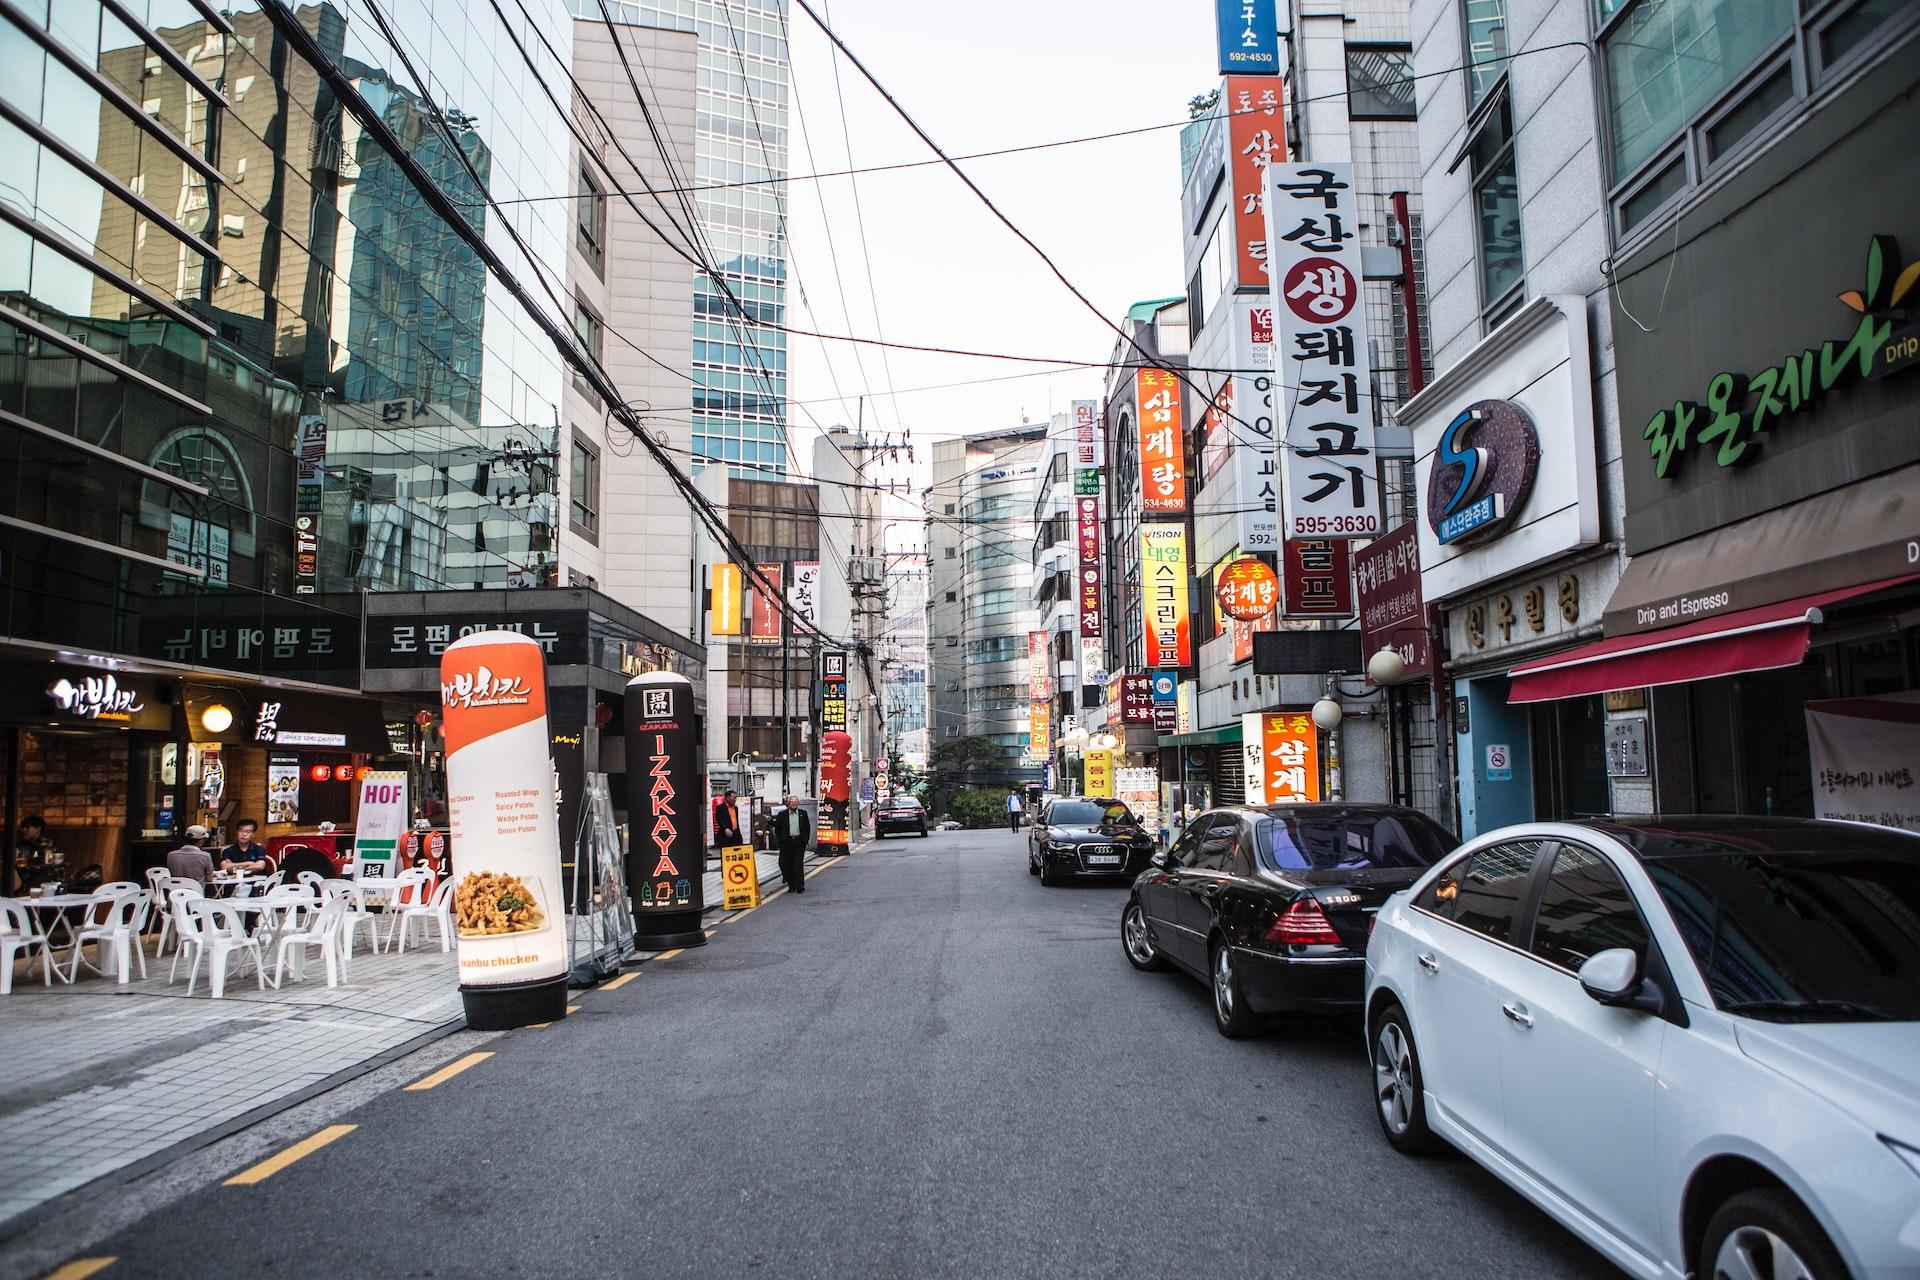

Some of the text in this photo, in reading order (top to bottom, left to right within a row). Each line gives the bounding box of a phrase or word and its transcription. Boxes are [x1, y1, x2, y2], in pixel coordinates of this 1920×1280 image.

[1240, 0, 1259, 47] 구소
[1229, 52, 1273, 62] 592-4530
[1277, 169, 1371, 509] 국산 생 돼지고기
[1885, 336, 1918, 366] Drip
[1140, 370, 1178, 388] 토종
[1077, 405, 1094, 463] 원룸텔
[1143, 389, 1183, 496] 삼계탕
[1144, 498, 1184, 509] 534-4630
[1295, 515, 1377, 534] 595-3630
[1441, 497, 1491, 540] 에스단란주점
[1147, 546, 1181, 562] 대영
[1227, 563, 1266, 580] 토종
[1219, 579, 1276, 605] 삼계탕
[1155, 564, 1179, 667] 스크린골프
[1230, 604, 1268, 615] 534-4630
[1637, 591, 1730, 626] Drip and Espresso
[390, 622, 560, 656] 로펌뉴
[498, 697, 528, 705] chicken
[1266, 715, 1310, 735] 토종
[364, 785, 403, 804] HOF
[495, 788, 540, 799] Roasted Wings
[496, 801, 535, 811] Spicy Potato
[648, 734, 679, 878] IZAKAYA
[496, 812, 539, 823] Wedge Potato
[497, 825, 537, 835] Onion Potato
[491, 954, 539, 967] chicken
